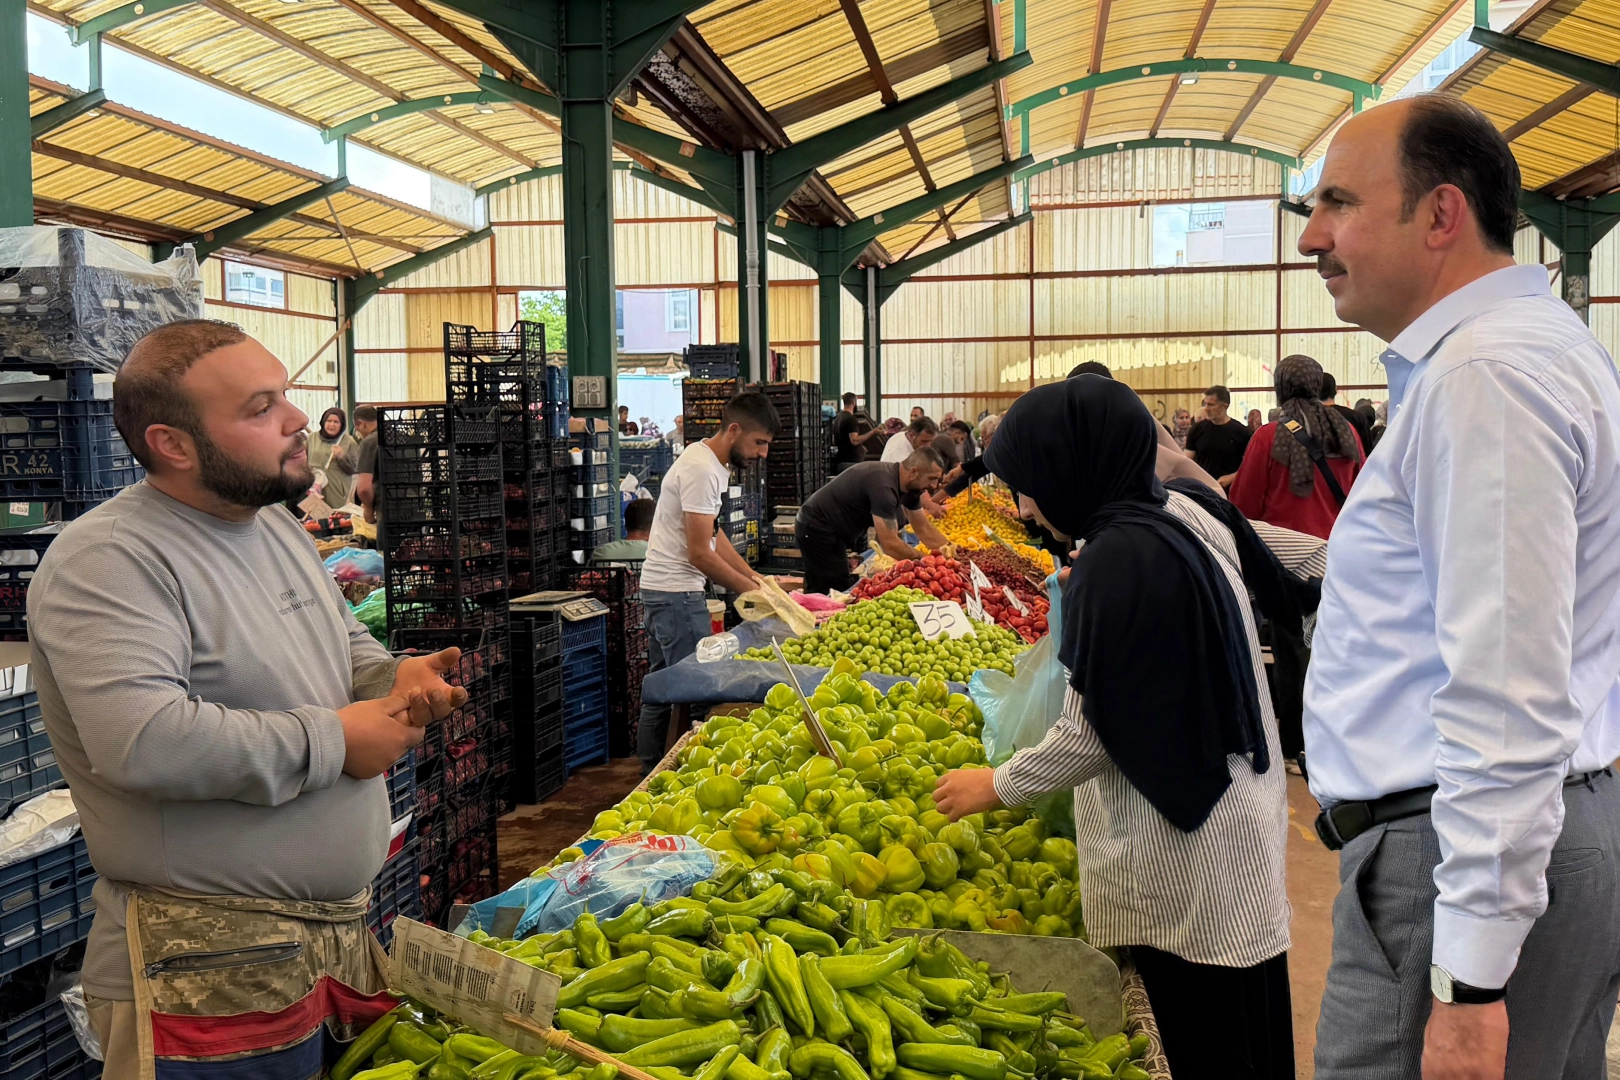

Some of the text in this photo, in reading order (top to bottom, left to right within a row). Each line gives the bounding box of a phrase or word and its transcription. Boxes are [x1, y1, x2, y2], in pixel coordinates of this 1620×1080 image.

[28, 454, 49, 467] 42
[24, 467, 54, 475] KONYA
[913, 603, 956, 637] 35
